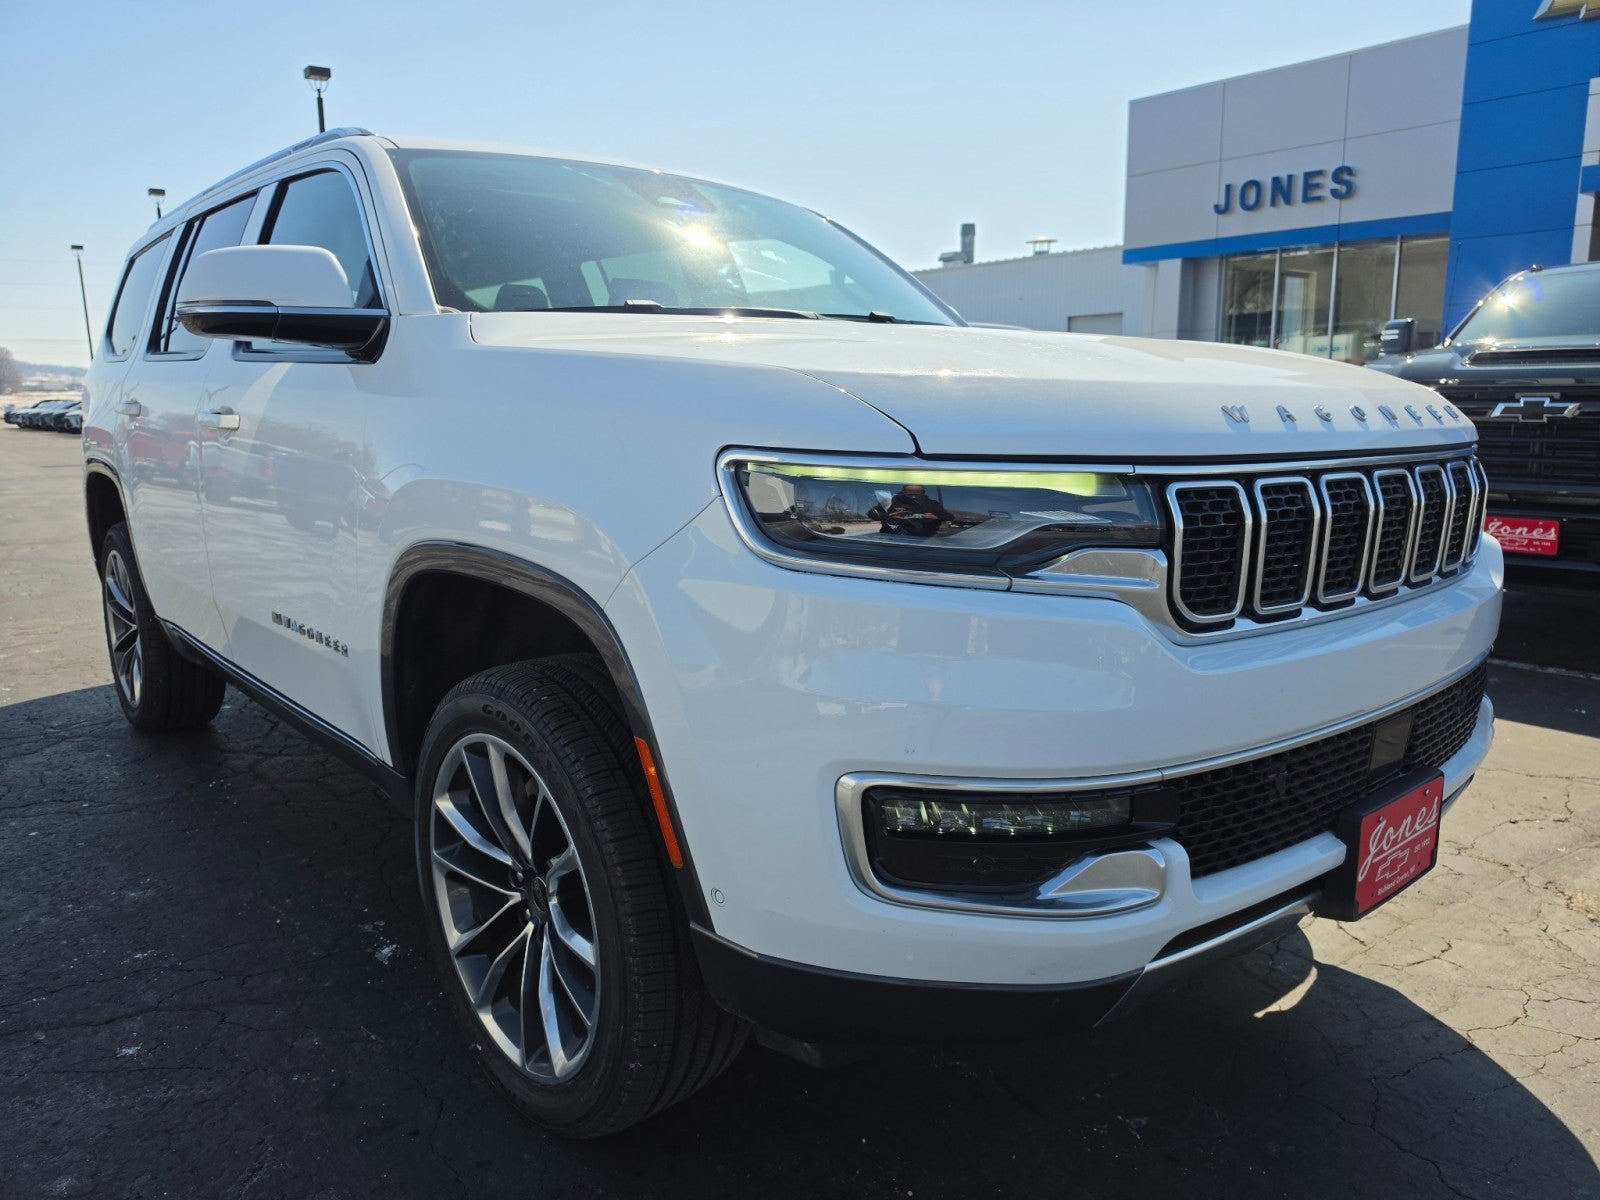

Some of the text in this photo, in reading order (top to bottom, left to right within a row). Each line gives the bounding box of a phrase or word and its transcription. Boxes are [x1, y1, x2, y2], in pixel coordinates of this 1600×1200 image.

[1213, 165, 1357, 215] JONES
[1221, 404, 1459, 424] WAGONEER
[283, 615, 349, 658] WAGONEER
[1358, 796, 1439, 882] Jones
